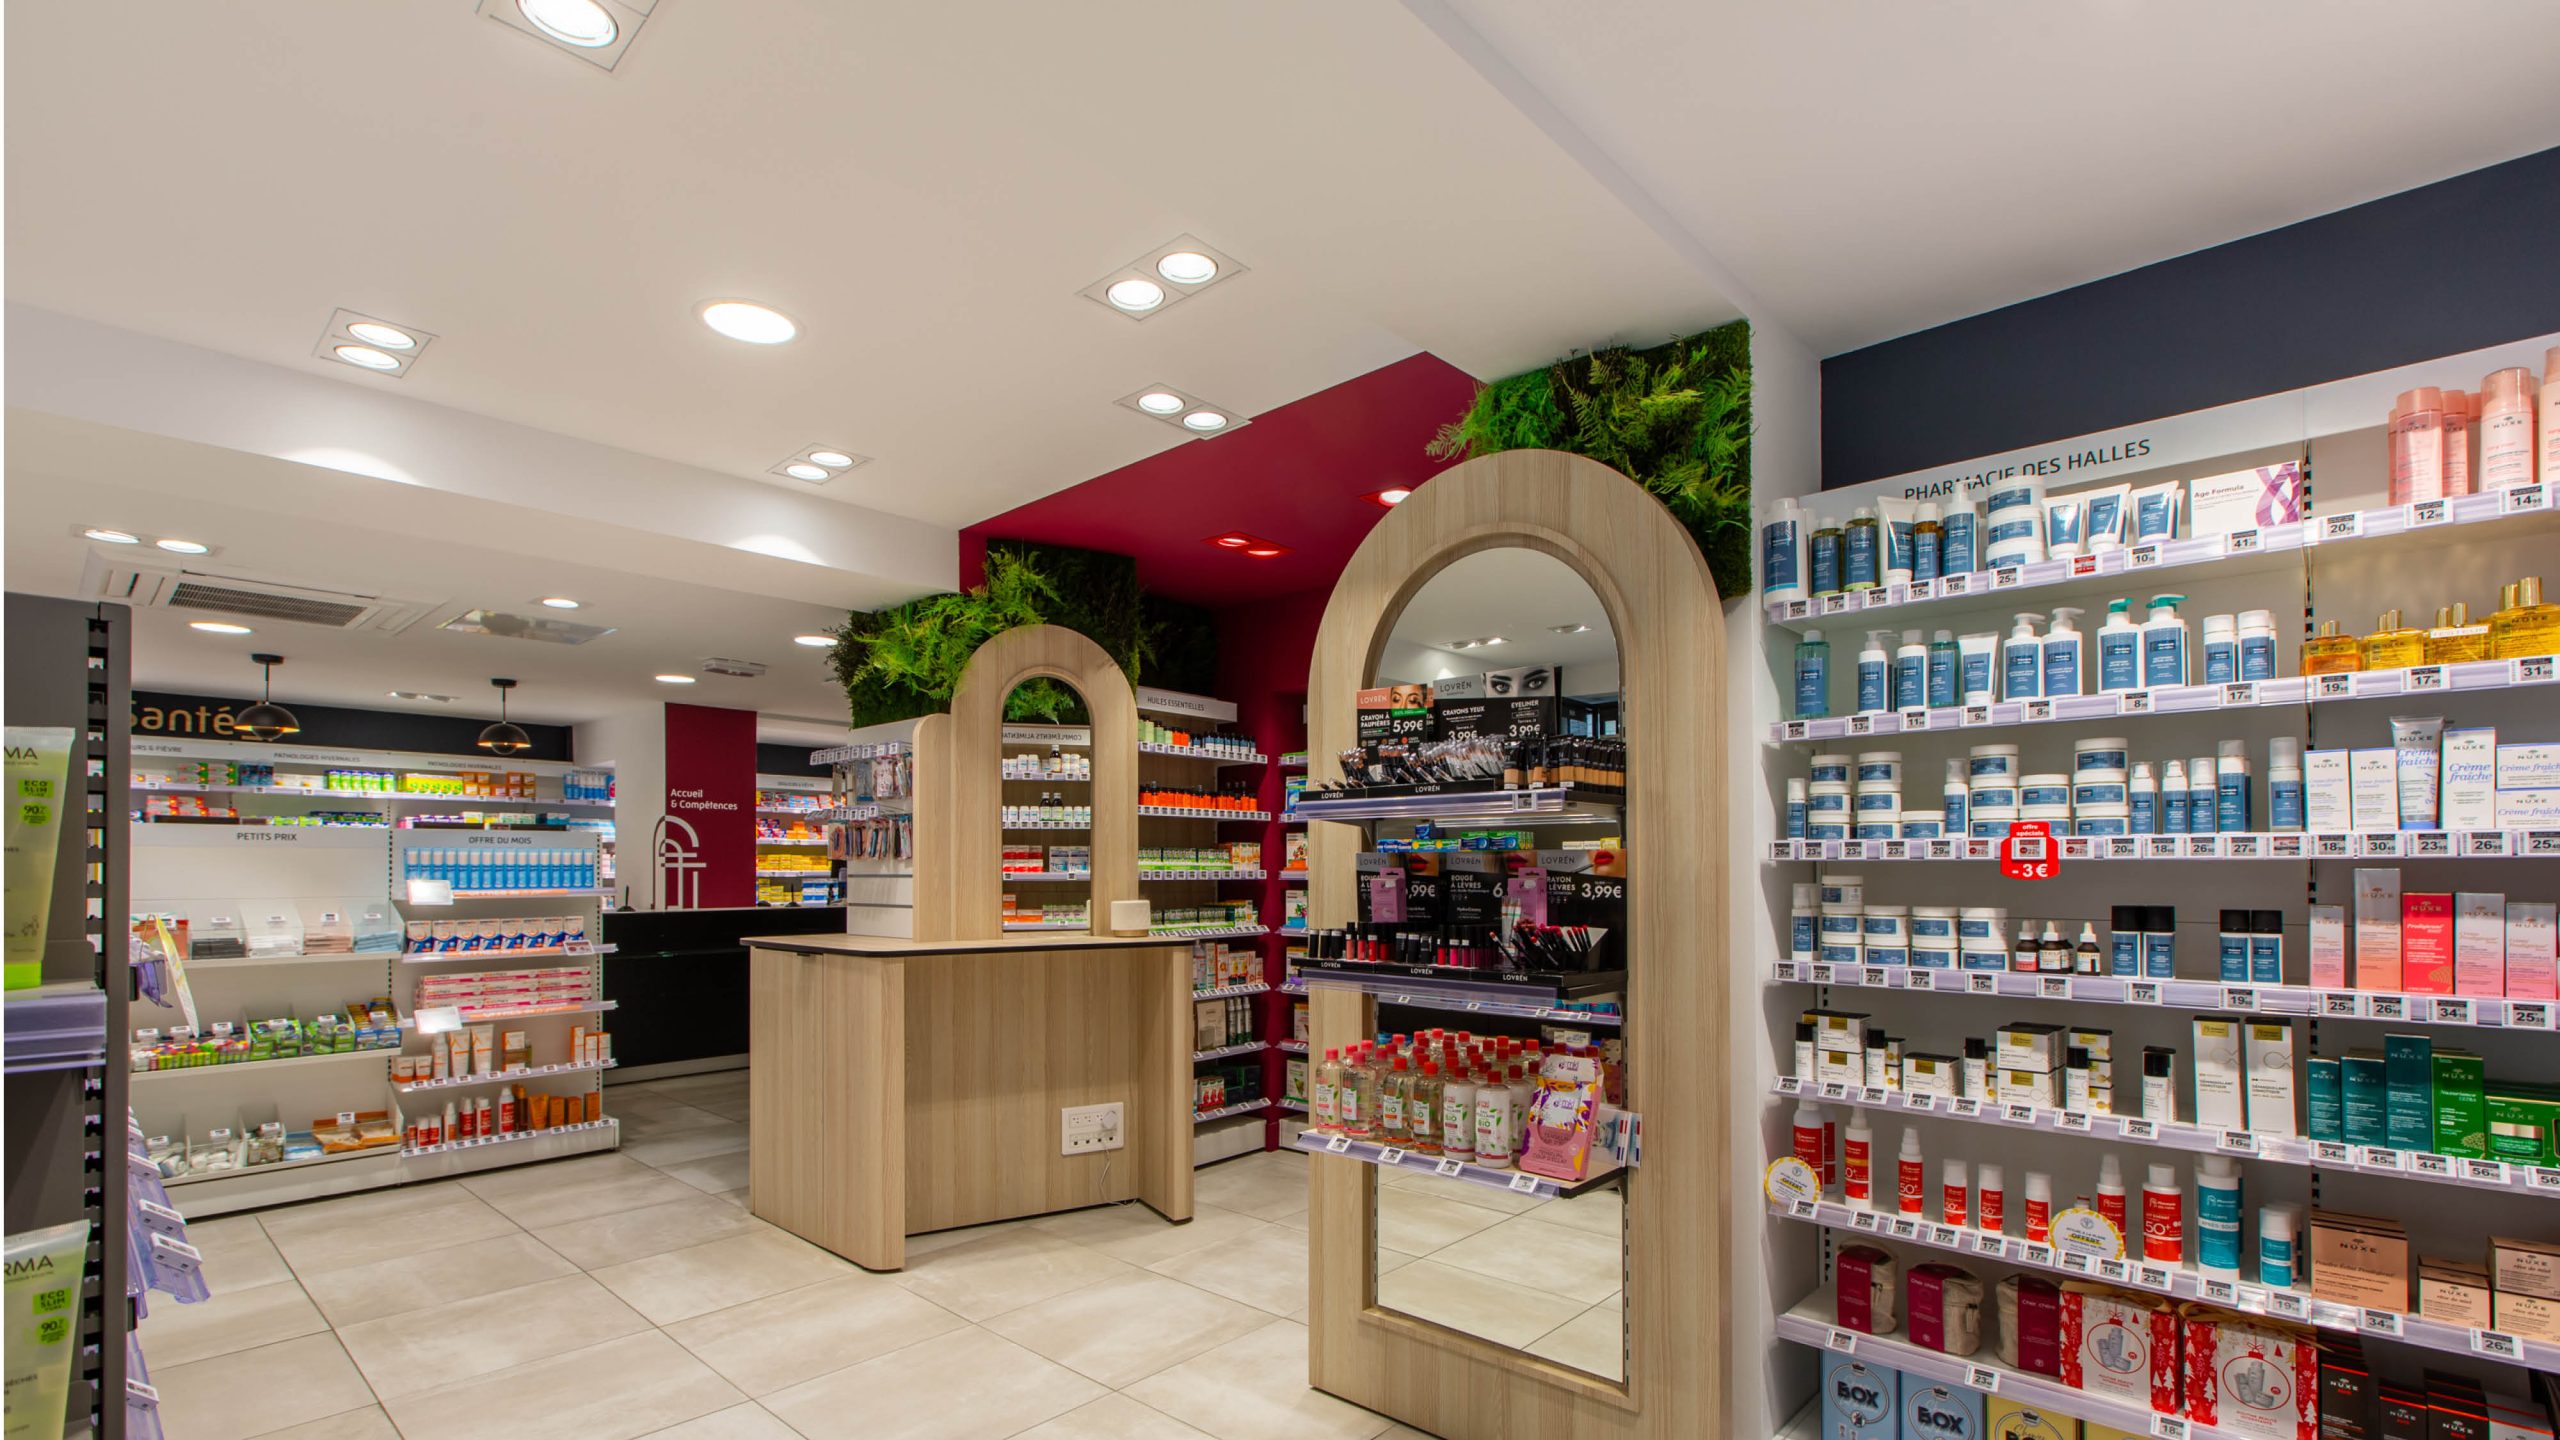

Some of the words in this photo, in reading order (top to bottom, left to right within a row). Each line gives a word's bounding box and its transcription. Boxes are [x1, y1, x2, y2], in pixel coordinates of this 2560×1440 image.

[2068, 438, 2150, 471] HALLES
[2194, 490, 2210, 498] Age
[2211, 484, 2244, 495] Formula
[1147, 695, 1168, 706] HUILES
[1510, 700, 1539, 709] EYELINER
[1442, 707, 1469, 716] CRAYONS
[1470, 705, 1486, 713] YEUX
[1392, 720, 1424, 734] 5,99€
[1508, 724, 1541, 738] 399€
[1448, 730, 1478, 741] 399€
[2449, 762, 2491, 772] Crème
[2446, 771, 2493, 784] fraîche
[670, 788, 703, 798] Accueil
[1415, 785, 1440, 793] LOVRÉN
[679, 800, 738, 811] Compétences
[237, 832, 272, 841] PETITS
[274, 832, 297, 841] PRIX
[468, 836, 494, 844] OFFRE
[510, 837, 532, 845] MOIS
[1405, 884, 1436, 900] ,99€
[1581, 883, 1622, 900] 3,99€
[1410, 967, 1433, 976] LOVRÉN
[1502, 973, 1528, 982] LOVRÉN
[2496, 1111, 2535, 1120] NUXE
[2339, 1243, 2378, 1253] NUXE
[2516, 1258, 2547, 1266] NUXE
[2440, 1289, 2469, 1297] NUXE
[2515, 1302, 2546, 1311] NUXE
[2330, 1380, 2359, 1391] NUXE
[1837, 1380, 1879, 1408] BOX
[1917, 1405, 1963, 1434] BOX
[2389, 1410, 2417, 1422] NUXE
[2442, 1422, 2474, 1434] NUXE
